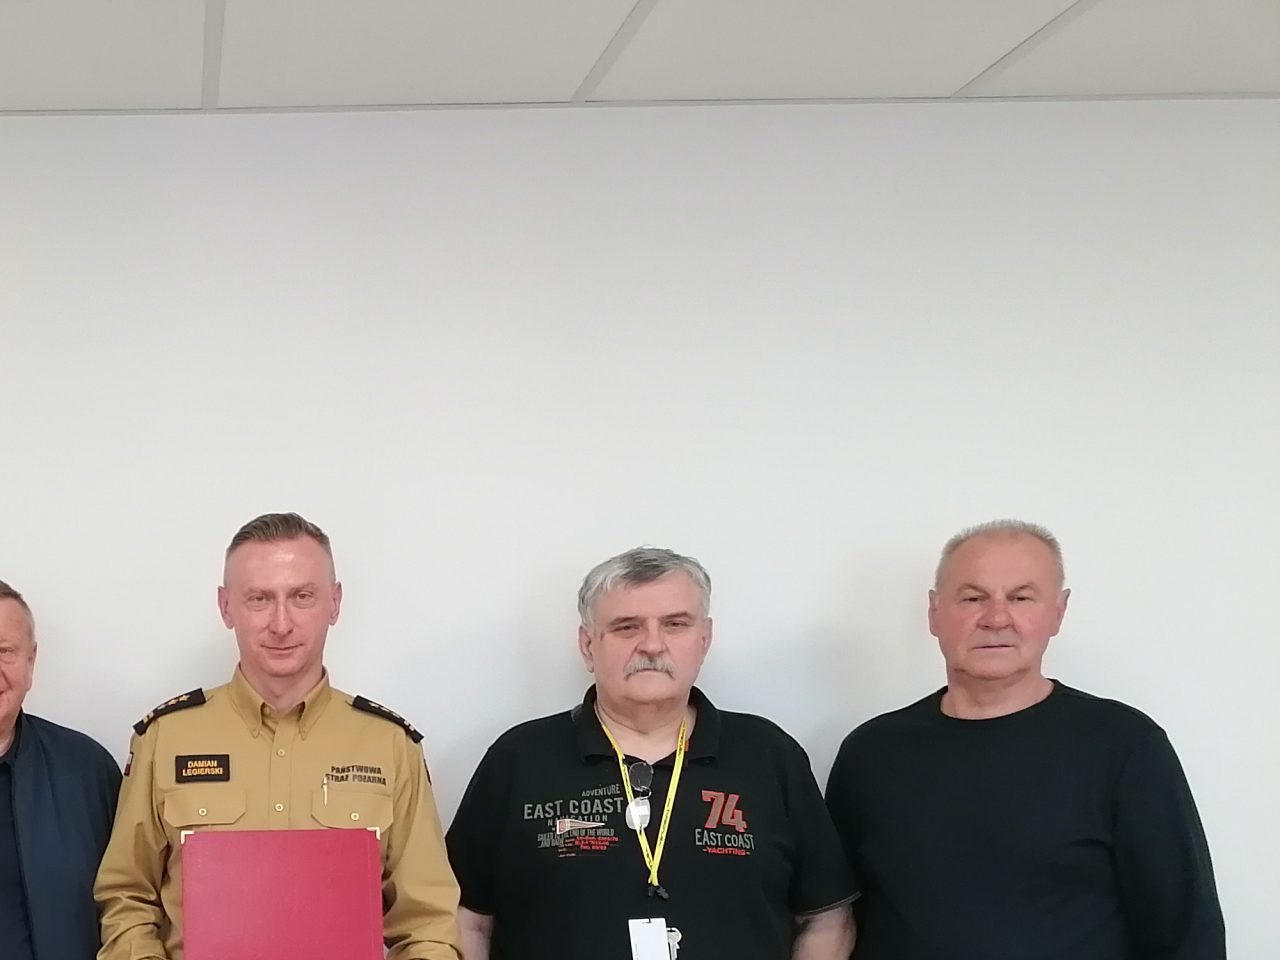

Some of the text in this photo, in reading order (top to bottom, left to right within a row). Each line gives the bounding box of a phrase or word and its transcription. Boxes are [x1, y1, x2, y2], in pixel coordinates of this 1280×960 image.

[182, 767, 223, 776] LEGIERSKI
[187, 760, 218, 768] DAMIAN
[582, 784, 620, 797] ADVENTURE
[523, 797, 624, 819] EAST COAST
[702, 789, 748, 832] 74
[695, 829, 754, 850] EAST COAST
